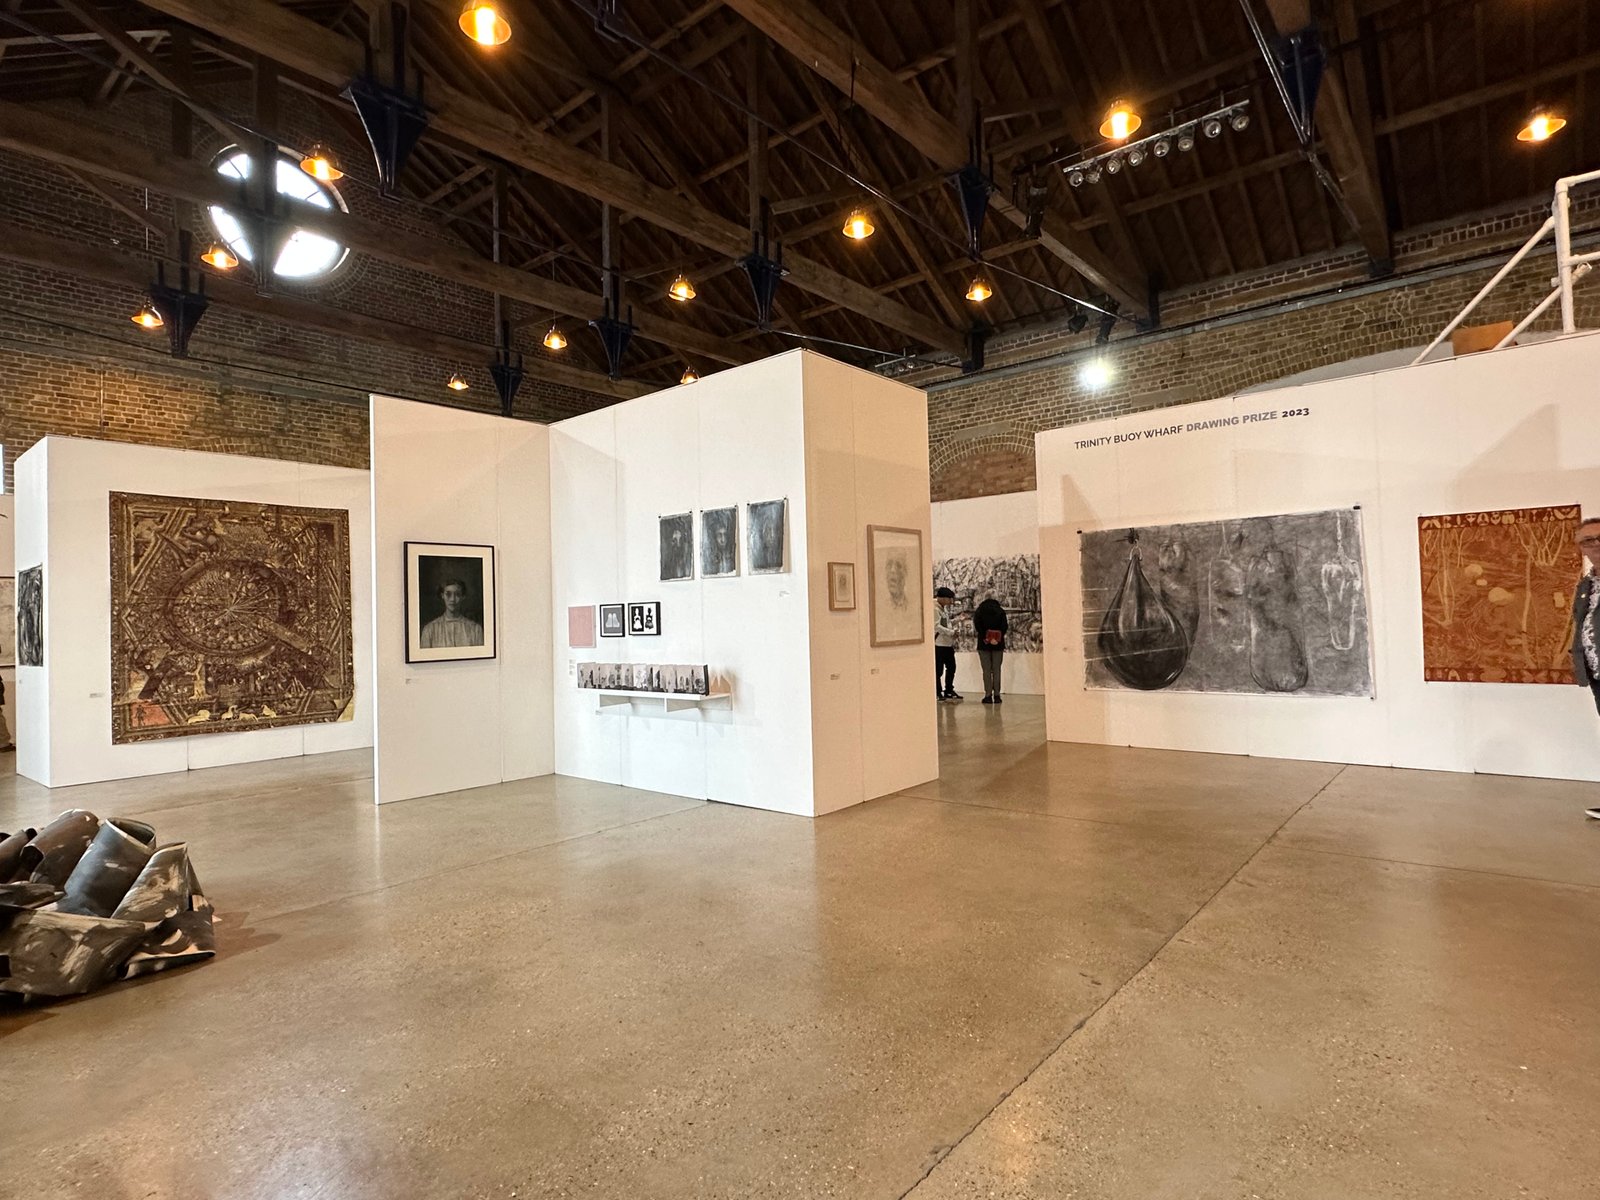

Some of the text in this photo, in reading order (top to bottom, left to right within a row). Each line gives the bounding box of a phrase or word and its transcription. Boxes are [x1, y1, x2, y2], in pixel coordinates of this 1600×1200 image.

[1074, 407, 1310, 450] TRINITY BUOY WHARF DRAWING PRIZE 2023
